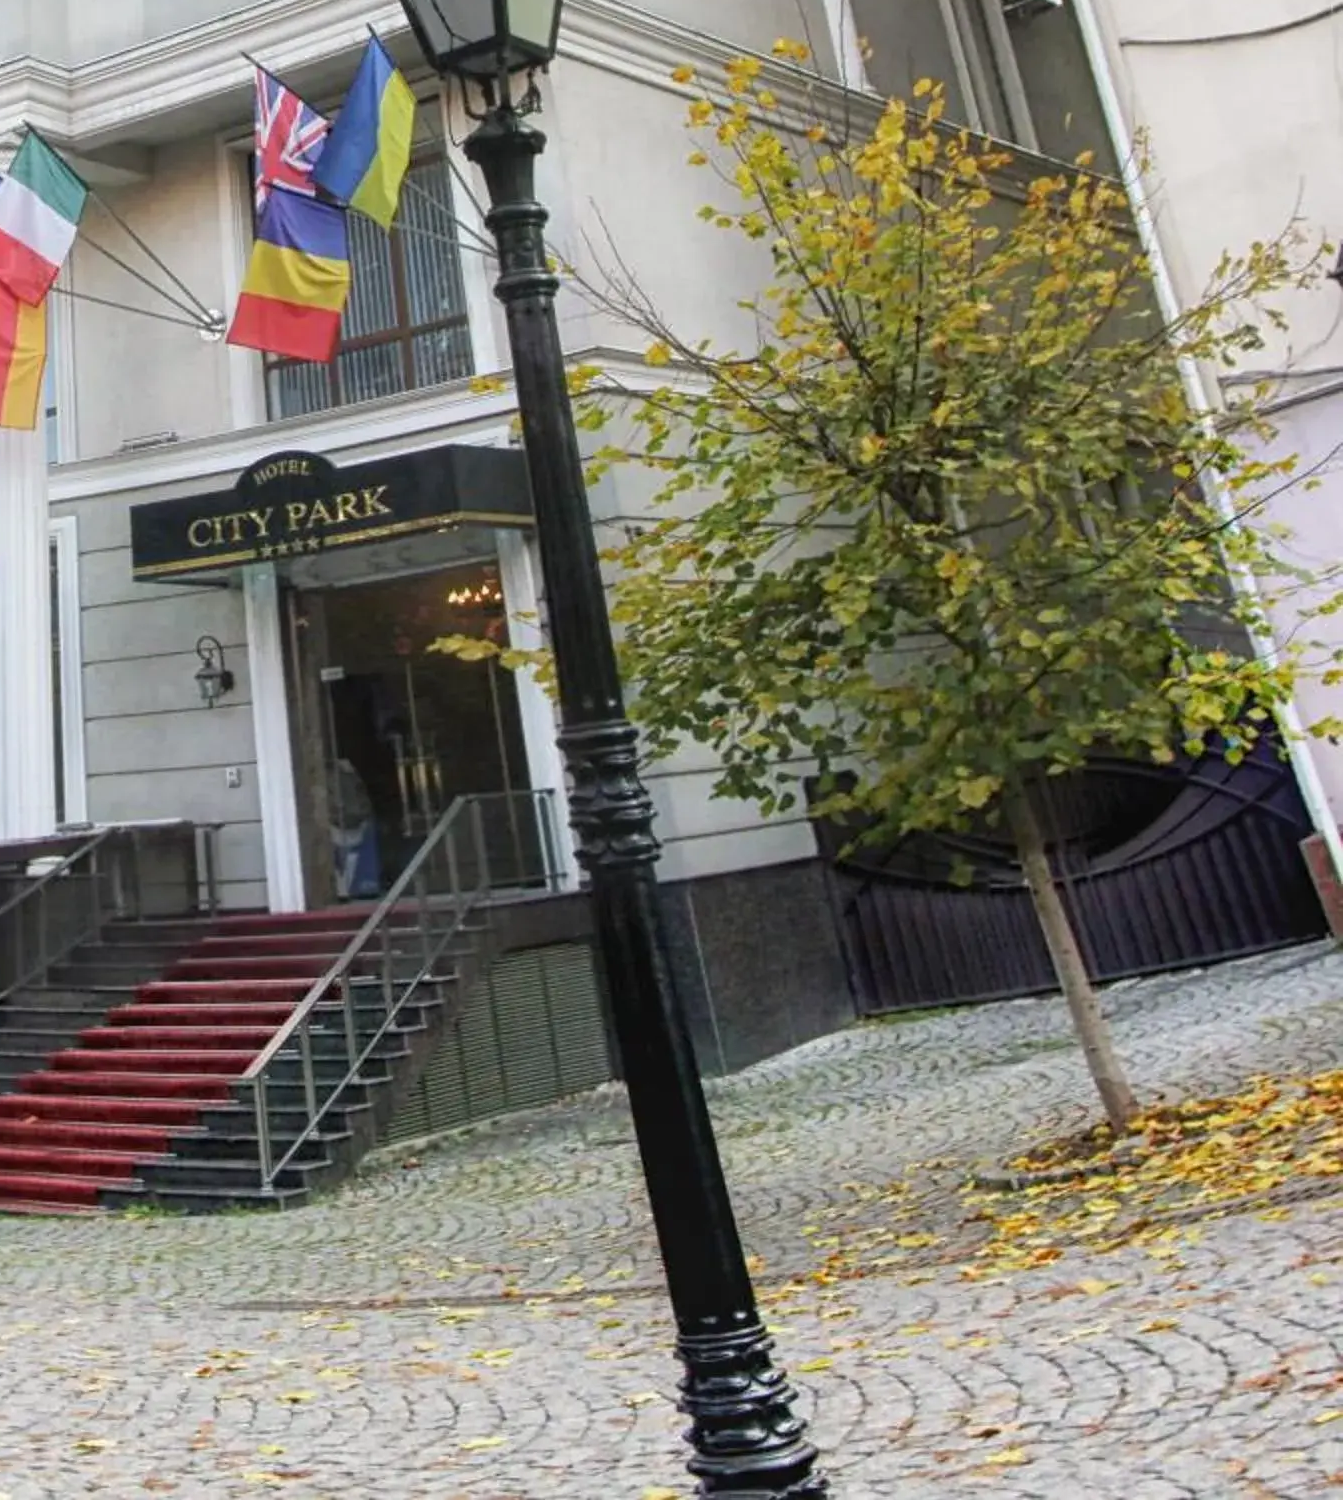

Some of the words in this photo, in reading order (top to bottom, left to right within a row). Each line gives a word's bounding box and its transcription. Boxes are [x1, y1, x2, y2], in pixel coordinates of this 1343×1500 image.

[254, 459, 312, 485] HOTEL
[187, 508, 273, 548] CITY
[287, 485, 393, 532] PARK
